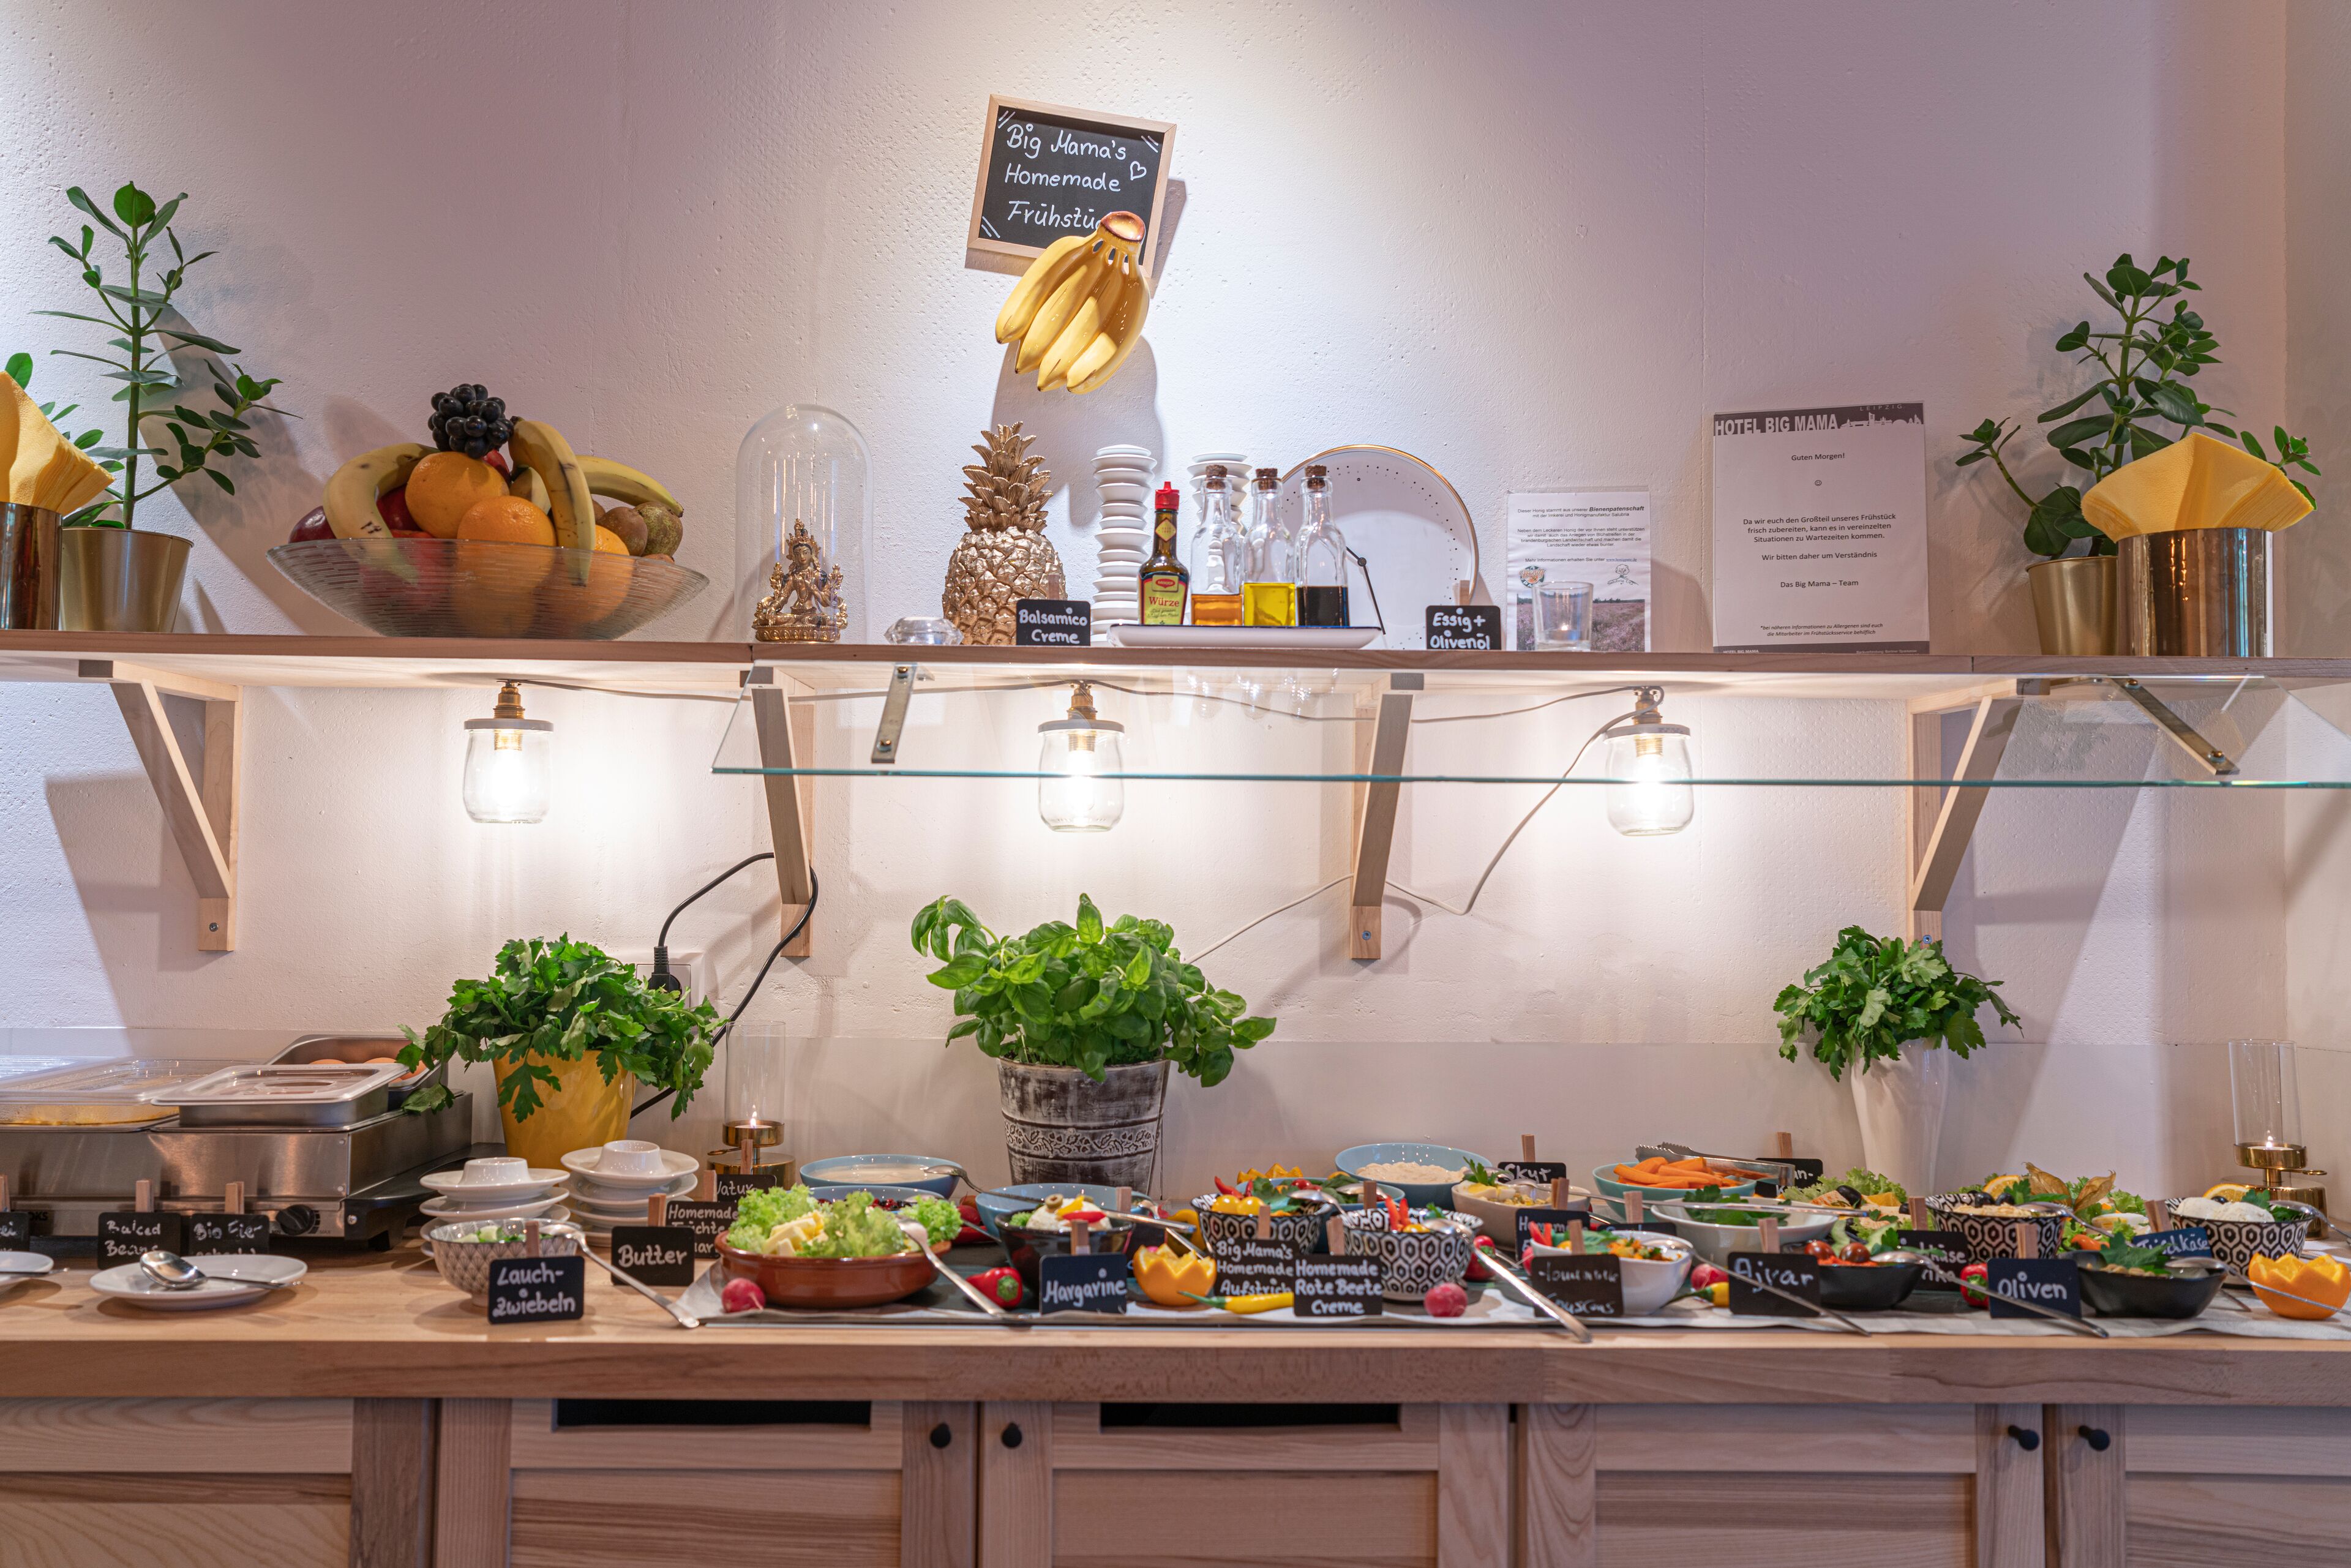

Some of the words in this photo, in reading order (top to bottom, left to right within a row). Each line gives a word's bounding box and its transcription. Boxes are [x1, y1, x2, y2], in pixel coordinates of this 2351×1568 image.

[1007, 123, 1041, 159] Big
[1051, 130, 1126, 160] Mama's
[1005, 163, 1121, 192] Homemade
[1715, 418, 1761, 435] HOTEL
[1765, 416, 1790, 432] BIG
[1794, 414, 1838, 431] MAMA
[1149, 597, 1179, 607] Würze
[1019, 607, 1087, 626] Balsamico
[1433, 607, 1472, 632] Essig
[1474, 615, 1486, 627] +
[1031, 629, 1080, 644] Creme
[1430, 630, 1490, 650] Olivenöl
[669, 1204, 738, 1220] Homemade
[193, 1221, 222, 1240] Bio
[617, 1244, 688, 1267] Butter
[1215, 1237, 1242, 1262] Big
[497, 1261, 564, 1286] Lauch-
[1217, 1259, 1294, 1277] Homemade
[1295, 1259, 1378, 1277] Homemade
[1295, 1278, 1334, 1296] Rote
[1335, 1278, 1382, 1296] Beete
[1998, 1271, 2068, 1300] Oliven
[492, 1288, 576, 1317] Zwiebeln
[1311, 1299, 1365, 1315] Creme
